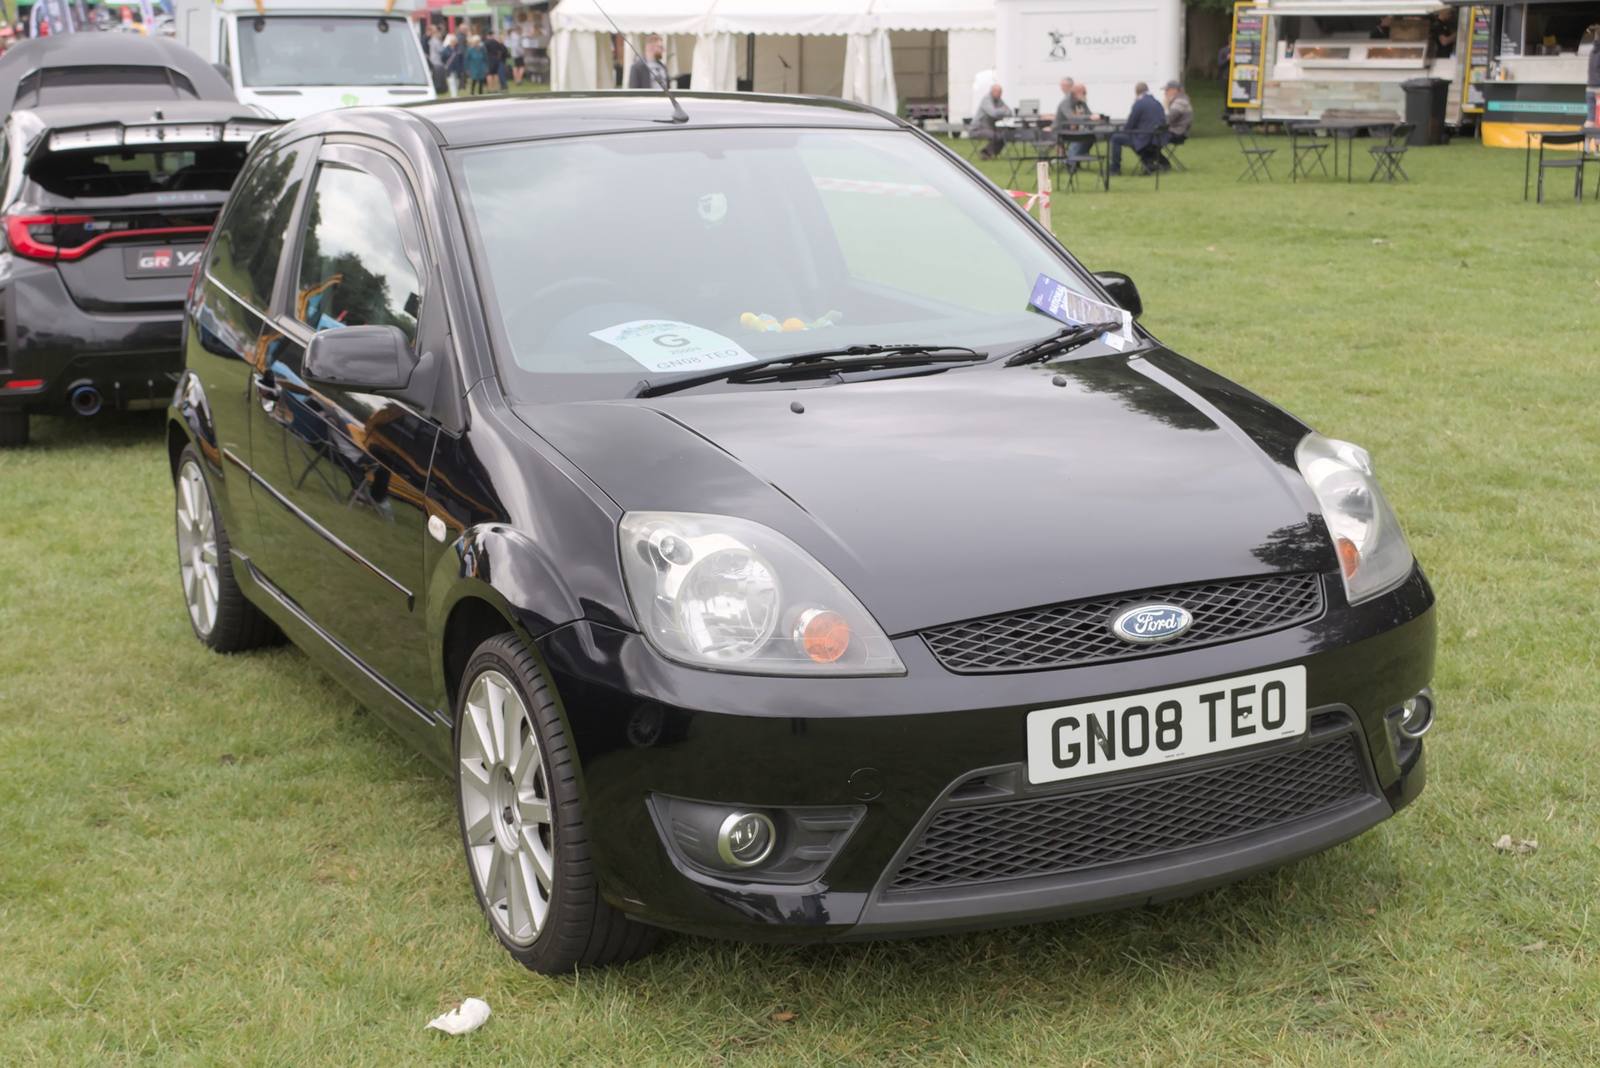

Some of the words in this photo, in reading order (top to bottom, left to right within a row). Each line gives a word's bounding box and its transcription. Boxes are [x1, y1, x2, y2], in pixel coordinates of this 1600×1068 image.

[140, 256, 170, 268] GR
[653, 334, 691, 348] G
[656, 356, 702, 370] GN08
[1135, 610, 1177, 633] Ford
[1051, 700, 1183, 769] GN08
[1199, 680, 1286, 743] TEO
